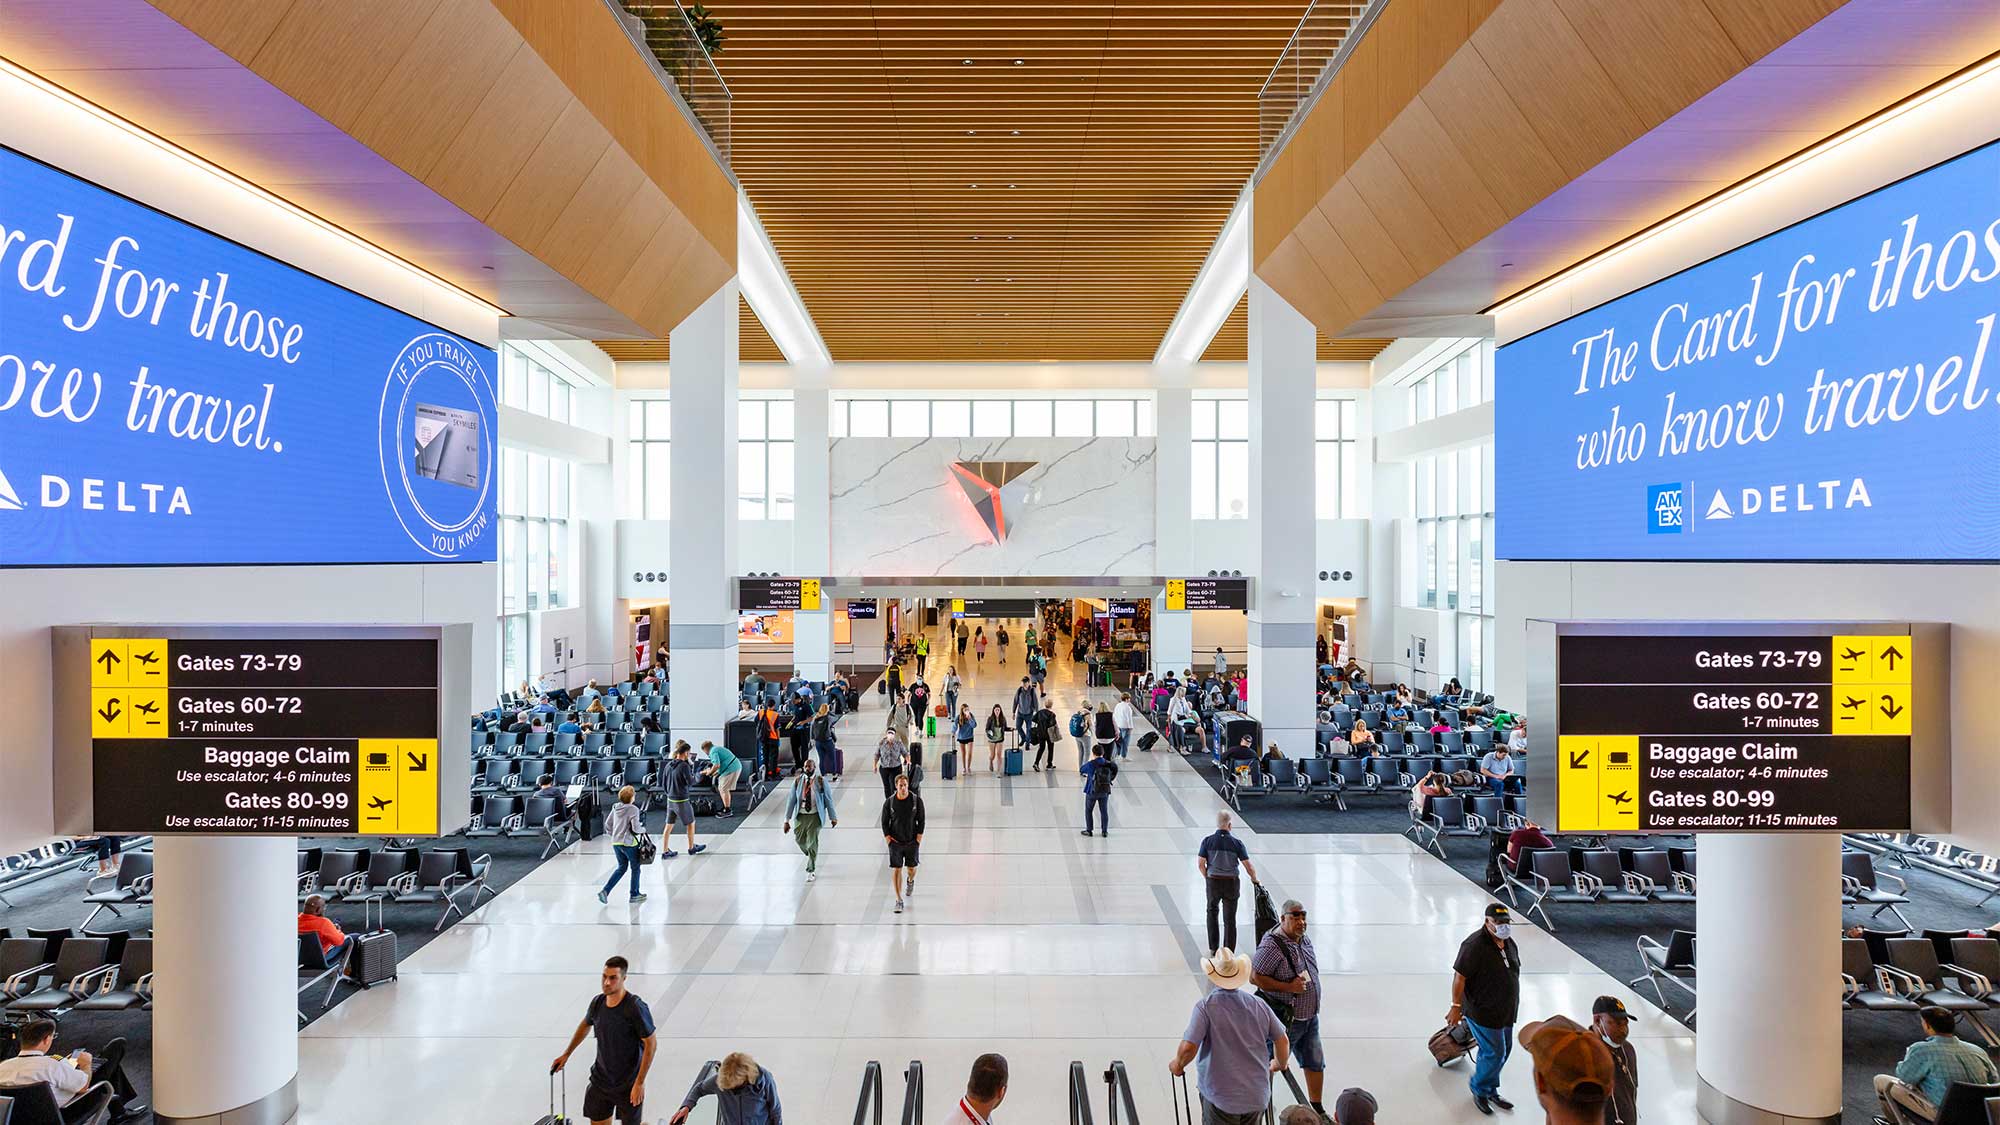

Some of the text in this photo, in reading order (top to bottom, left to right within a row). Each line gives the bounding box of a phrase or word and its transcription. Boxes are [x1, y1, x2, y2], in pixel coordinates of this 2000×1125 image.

[62, 236, 179, 332] for
[189, 272, 304, 364] those
[1571, 327, 1638, 395] The
[1650, 271, 1763, 373] Card
[1755, 254, 1856, 366] for
[396, 341, 478, 385] IF YOU TRAVEL
[126, 366, 283, 453] travel.
[1576, 405, 1647, 470] who
[1658, 392, 1784, 457] know
[41, 474, 192, 515] DELTA
[1655, 490, 1682, 510] AM
[1742, 478, 1872, 515] DELTA
[1659, 508, 1682, 527] EX
[432, 511, 487, 552] YOU KNOW
[1110, 606, 1136, 614] Atlanta
[177, 654, 302, 671] Gates 73-79
[1695, 650, 1822, 668] Gates 73-79
[178, 696, 302, 714] Gates 60-72
[1693, 692, 1819, 710] Gates 60-72
[178, 720, 254, 733] 1-7 minutes
[1742, 715, 1820, 728] 1-7 minutes
[204, 746, 350, 768] Baggage Claim
[1649, 742, 1798, 764] Baggage Claim
[176, 770, 352, 784] Use escalator; 4-6 minutes
[1650, 766, 1829, 781] Use escalator; 4-6 minutes
[225, 791, 349, 809] Gates 80-99
[1648, 790, 1775, 808] Gates 80-99
[165, 815, 350, 829] Use escalator; 11-15 minutes
[1649, 813, 1838, 828] Use escalator; 11-15 minutes
